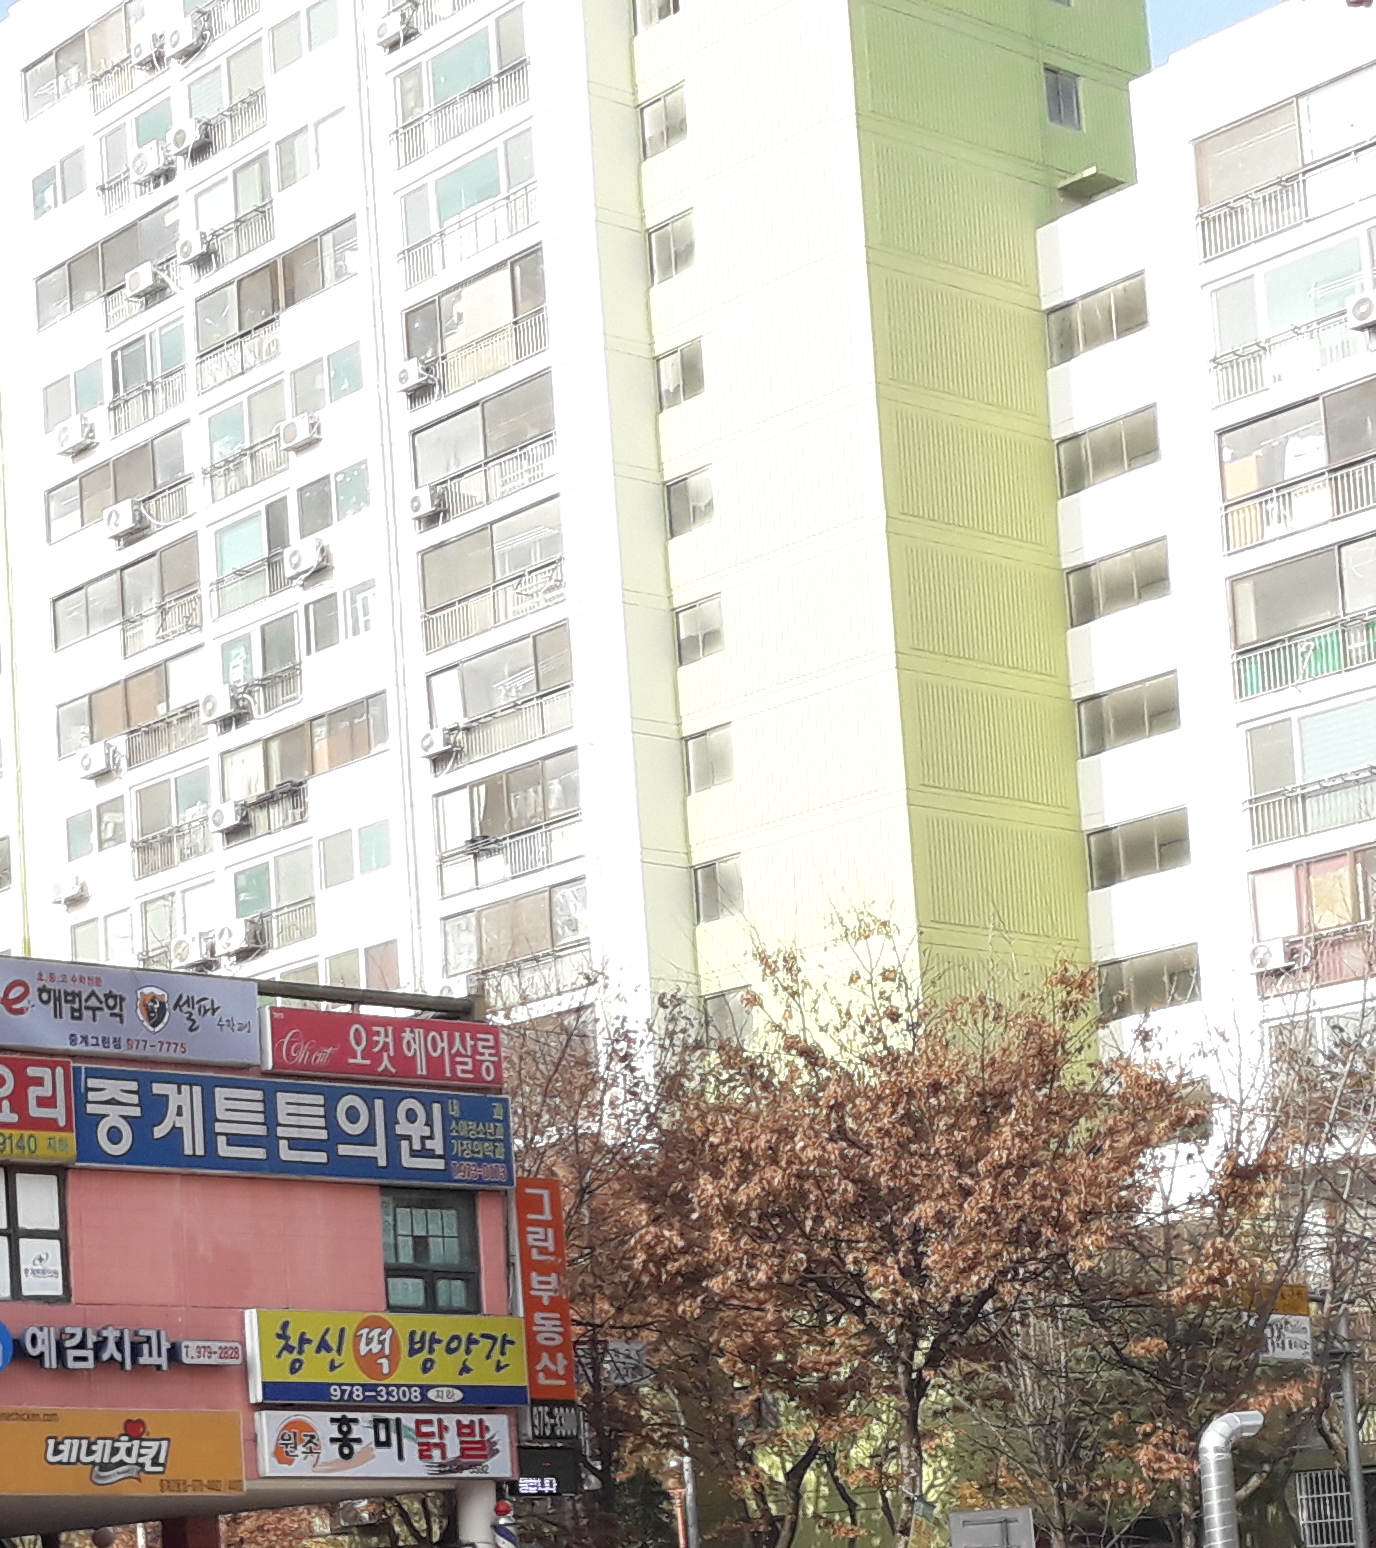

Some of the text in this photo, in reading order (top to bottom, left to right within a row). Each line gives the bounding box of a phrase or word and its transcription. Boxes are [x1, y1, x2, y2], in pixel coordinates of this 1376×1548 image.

[36, 984, 128, 1025] 해법수학
[400, 1025, 499, 1083] 헤어살롱
[85, 1076, 448, 1172] 중계튼튼의원
[524, 1187, 569, 1387] 그린부동산
[22, 1325, 172, 1372] 예감치과
[407, 1328, 517, 1377] 방앗간
[329, 1384, 422, 1402] 978-3308
[46, 1435, 171, 1473] 네네치킨
[279, 1430, 323, 1460] 원조
